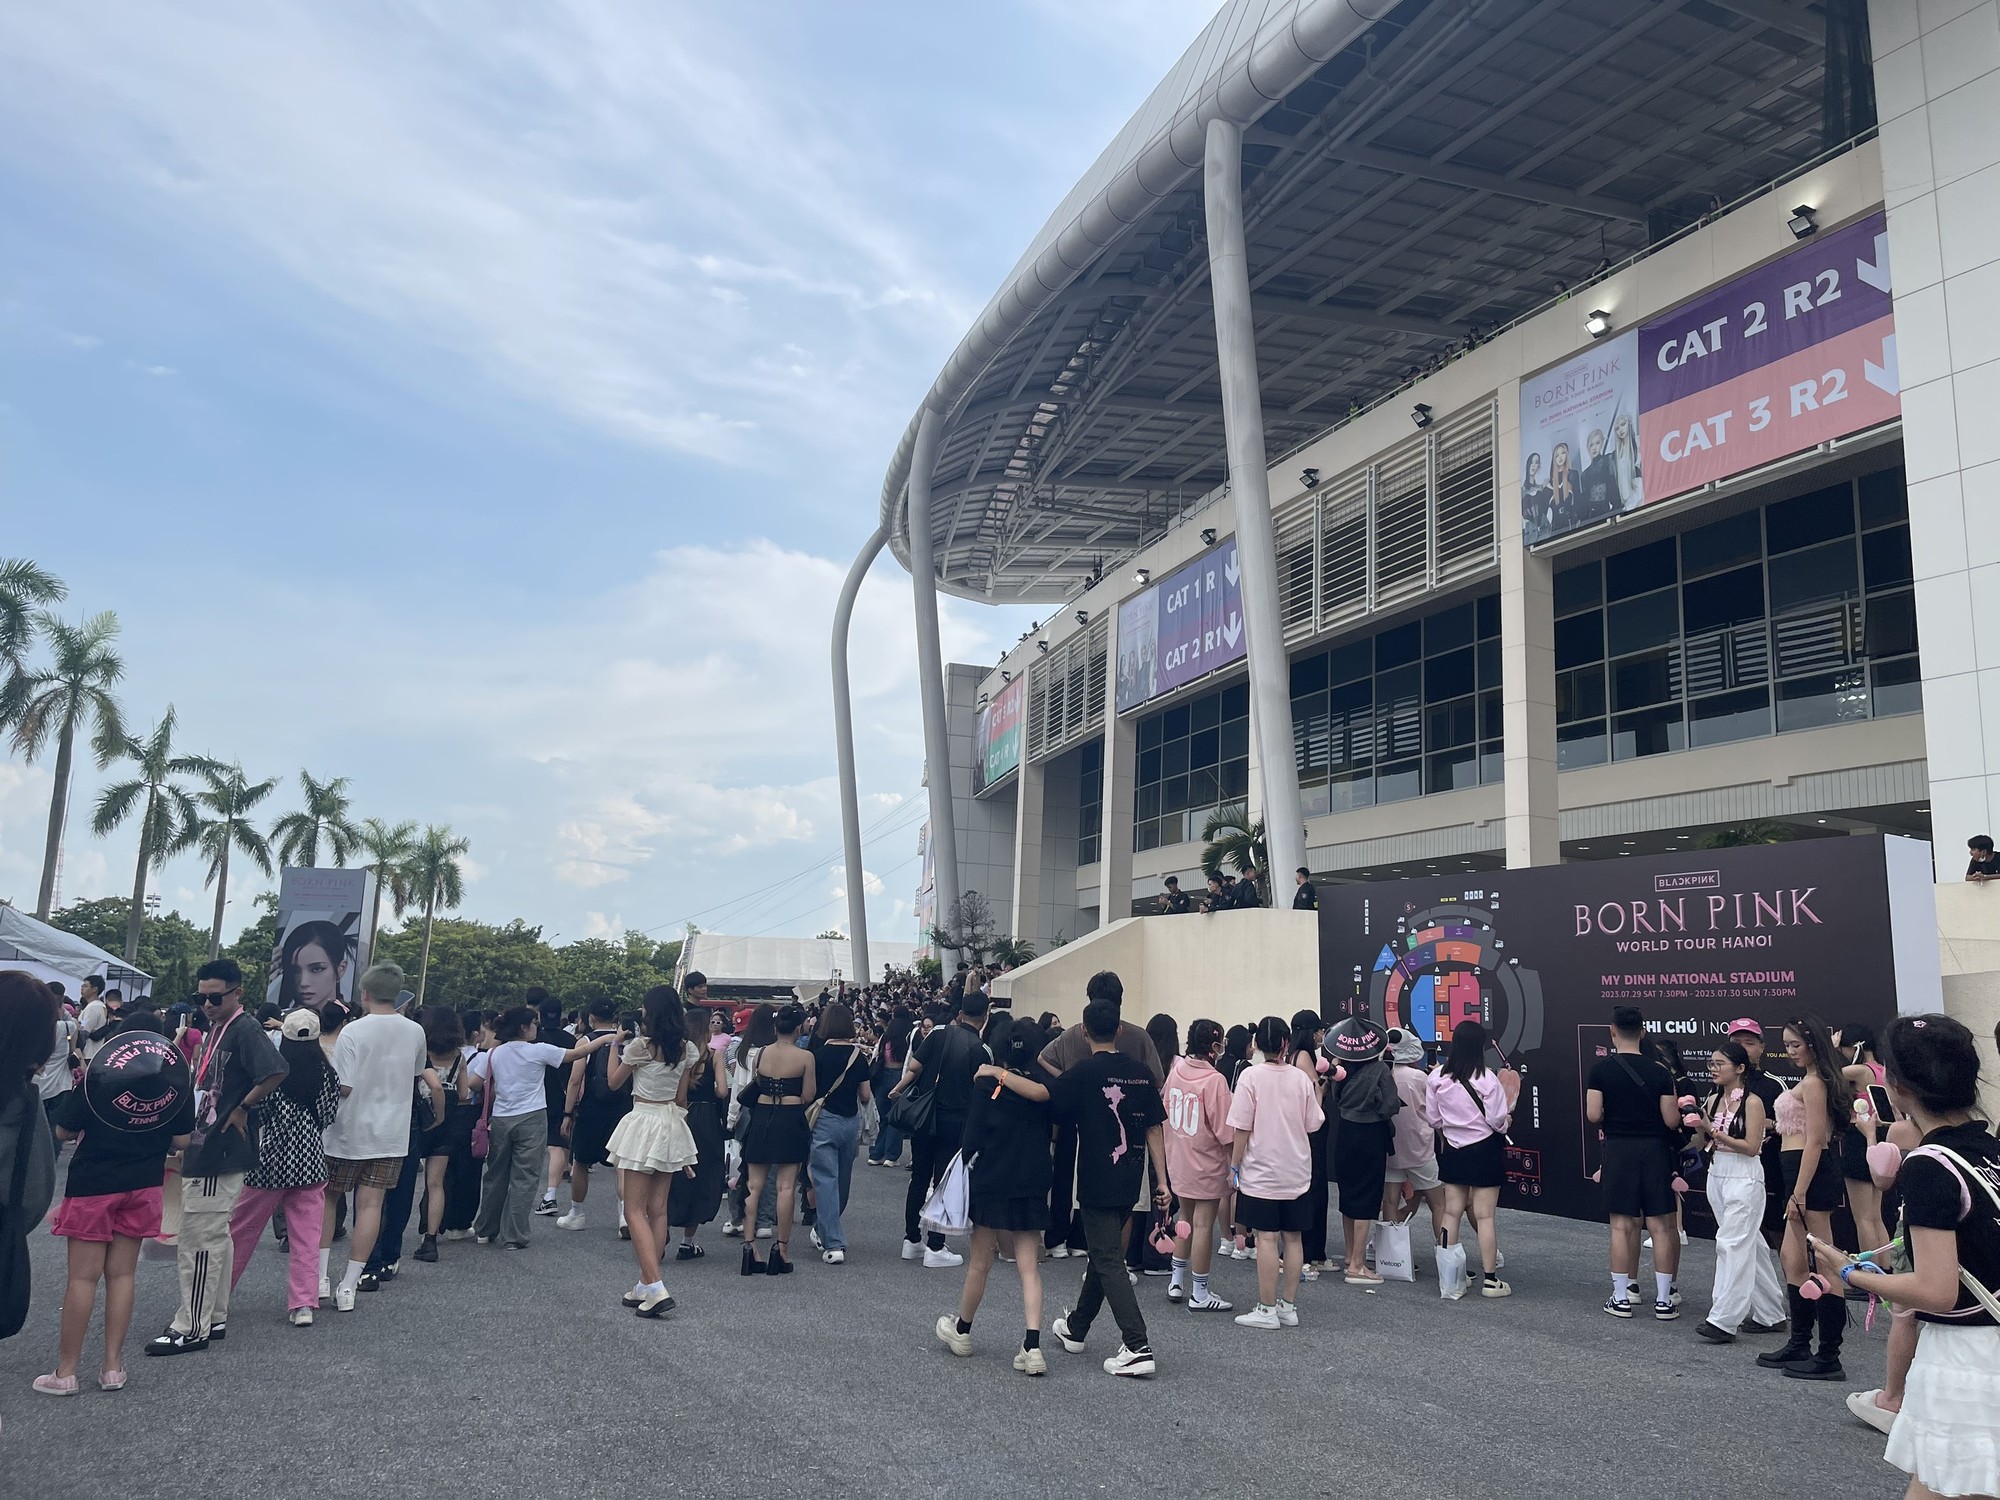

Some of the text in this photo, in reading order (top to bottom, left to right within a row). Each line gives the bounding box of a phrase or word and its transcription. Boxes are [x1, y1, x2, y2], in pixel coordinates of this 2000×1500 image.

[1657, 268, 1842, 372] CAT 2 R2
[1534, 378, 1576, 409] BORN
[1583, 358, 1621, 387] PINK
[1659, 368, 1848, 463] CAT 3 R2
[1166, 570, 1216, 614] CAT 1 R
[1165, 626, 1221, 671] CAT 2 R1
[1573, 886, 1823, 937] BORN PINK
[1616, 934, 1773, 952] WORLD TOUR HANOI
[1601, 970, 1795, 986] MY DINH NATIONAL STADIUM
[1601, 990, 1642, 998] 2023.07.29
[1643, 990, 1657, 998] SAT
[1659, 989, 1688, 997] 7:30PM
[1694, 989, 1740, 998] 2023.07.30
[1742, 988, 1761, 997] SUN
[1763, 988, 1796, 997] 7:30PM
[1337, 1030, 1376, 1045] BORN PINK
[1665, 1018, 1698, 1034] CHÚ
[112, 1045, 176, 1070] BORN PINK
[128, 1113, 160, 1124] JENNIE
